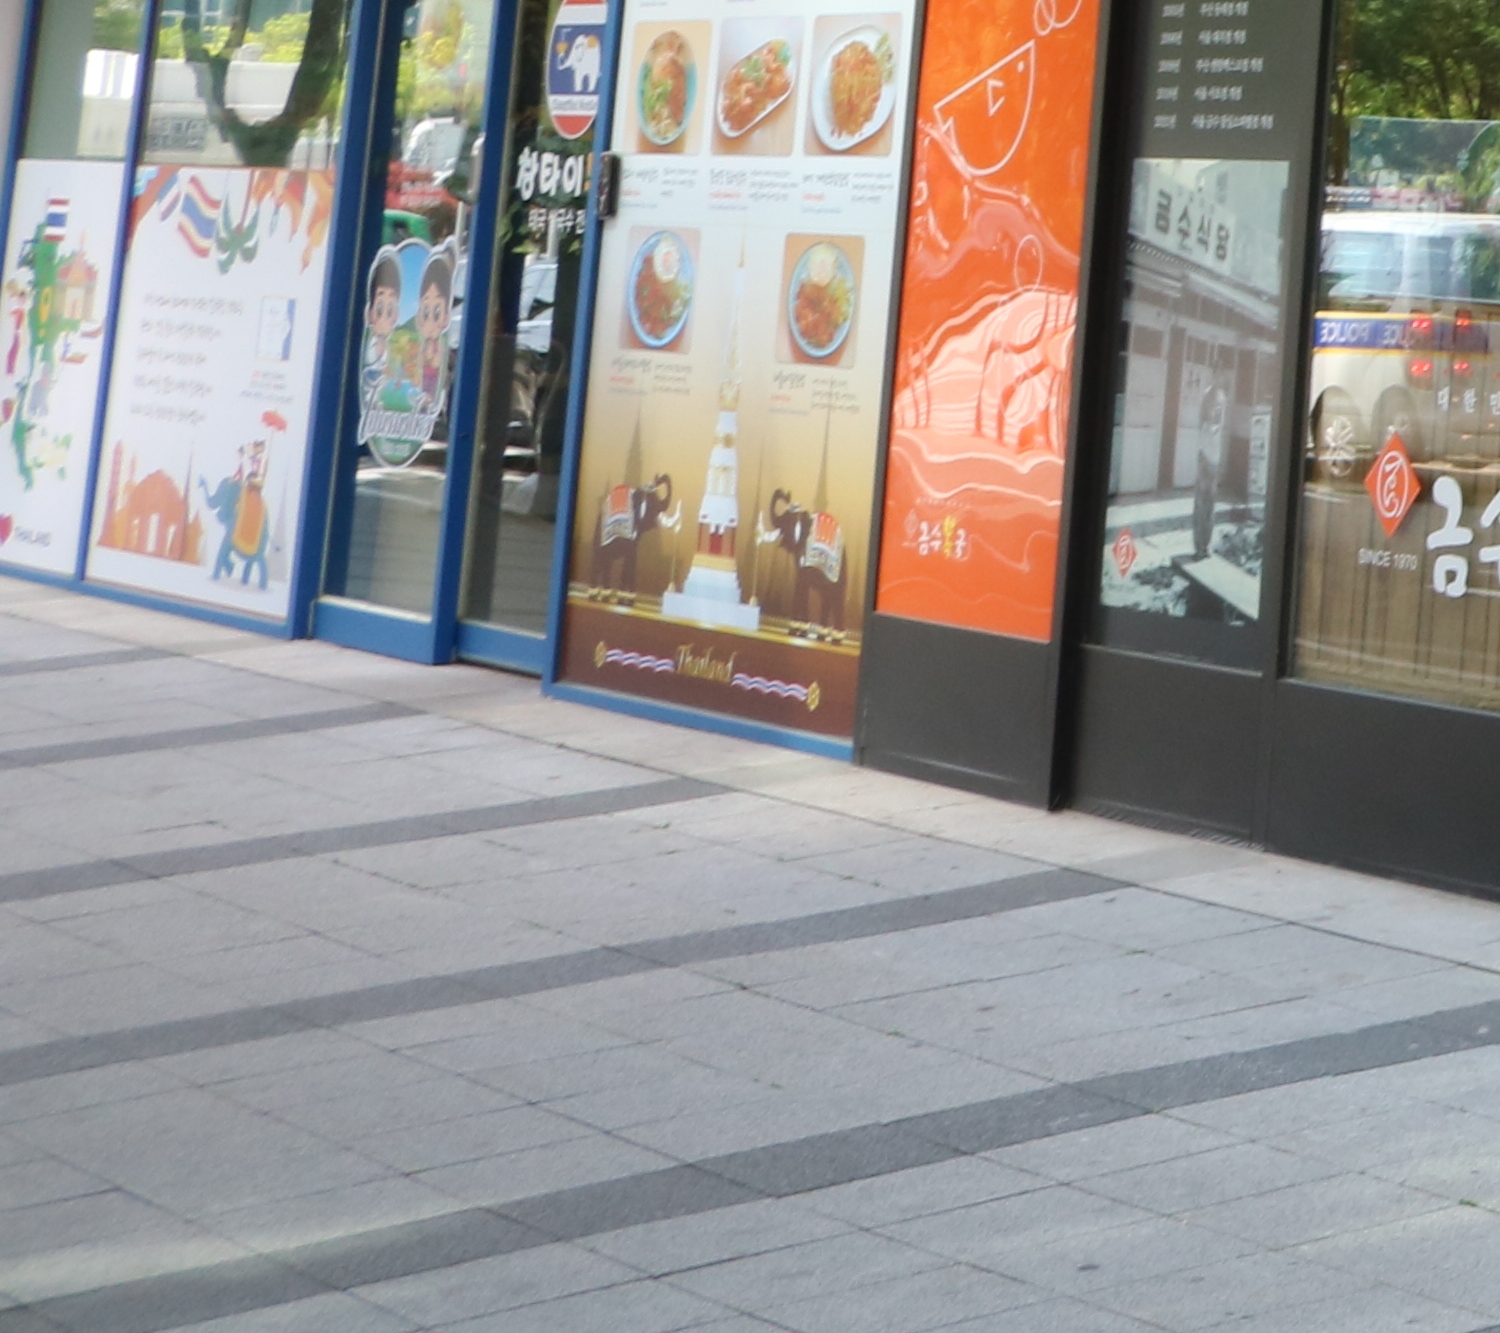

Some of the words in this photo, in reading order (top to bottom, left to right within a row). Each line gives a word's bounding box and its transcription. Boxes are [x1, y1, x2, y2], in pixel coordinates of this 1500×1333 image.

[917, 515, 967, 559] 금수복국
[1358, 546, 1391, 569] SINCE
[1393, 550, 1418, 572] 1970
